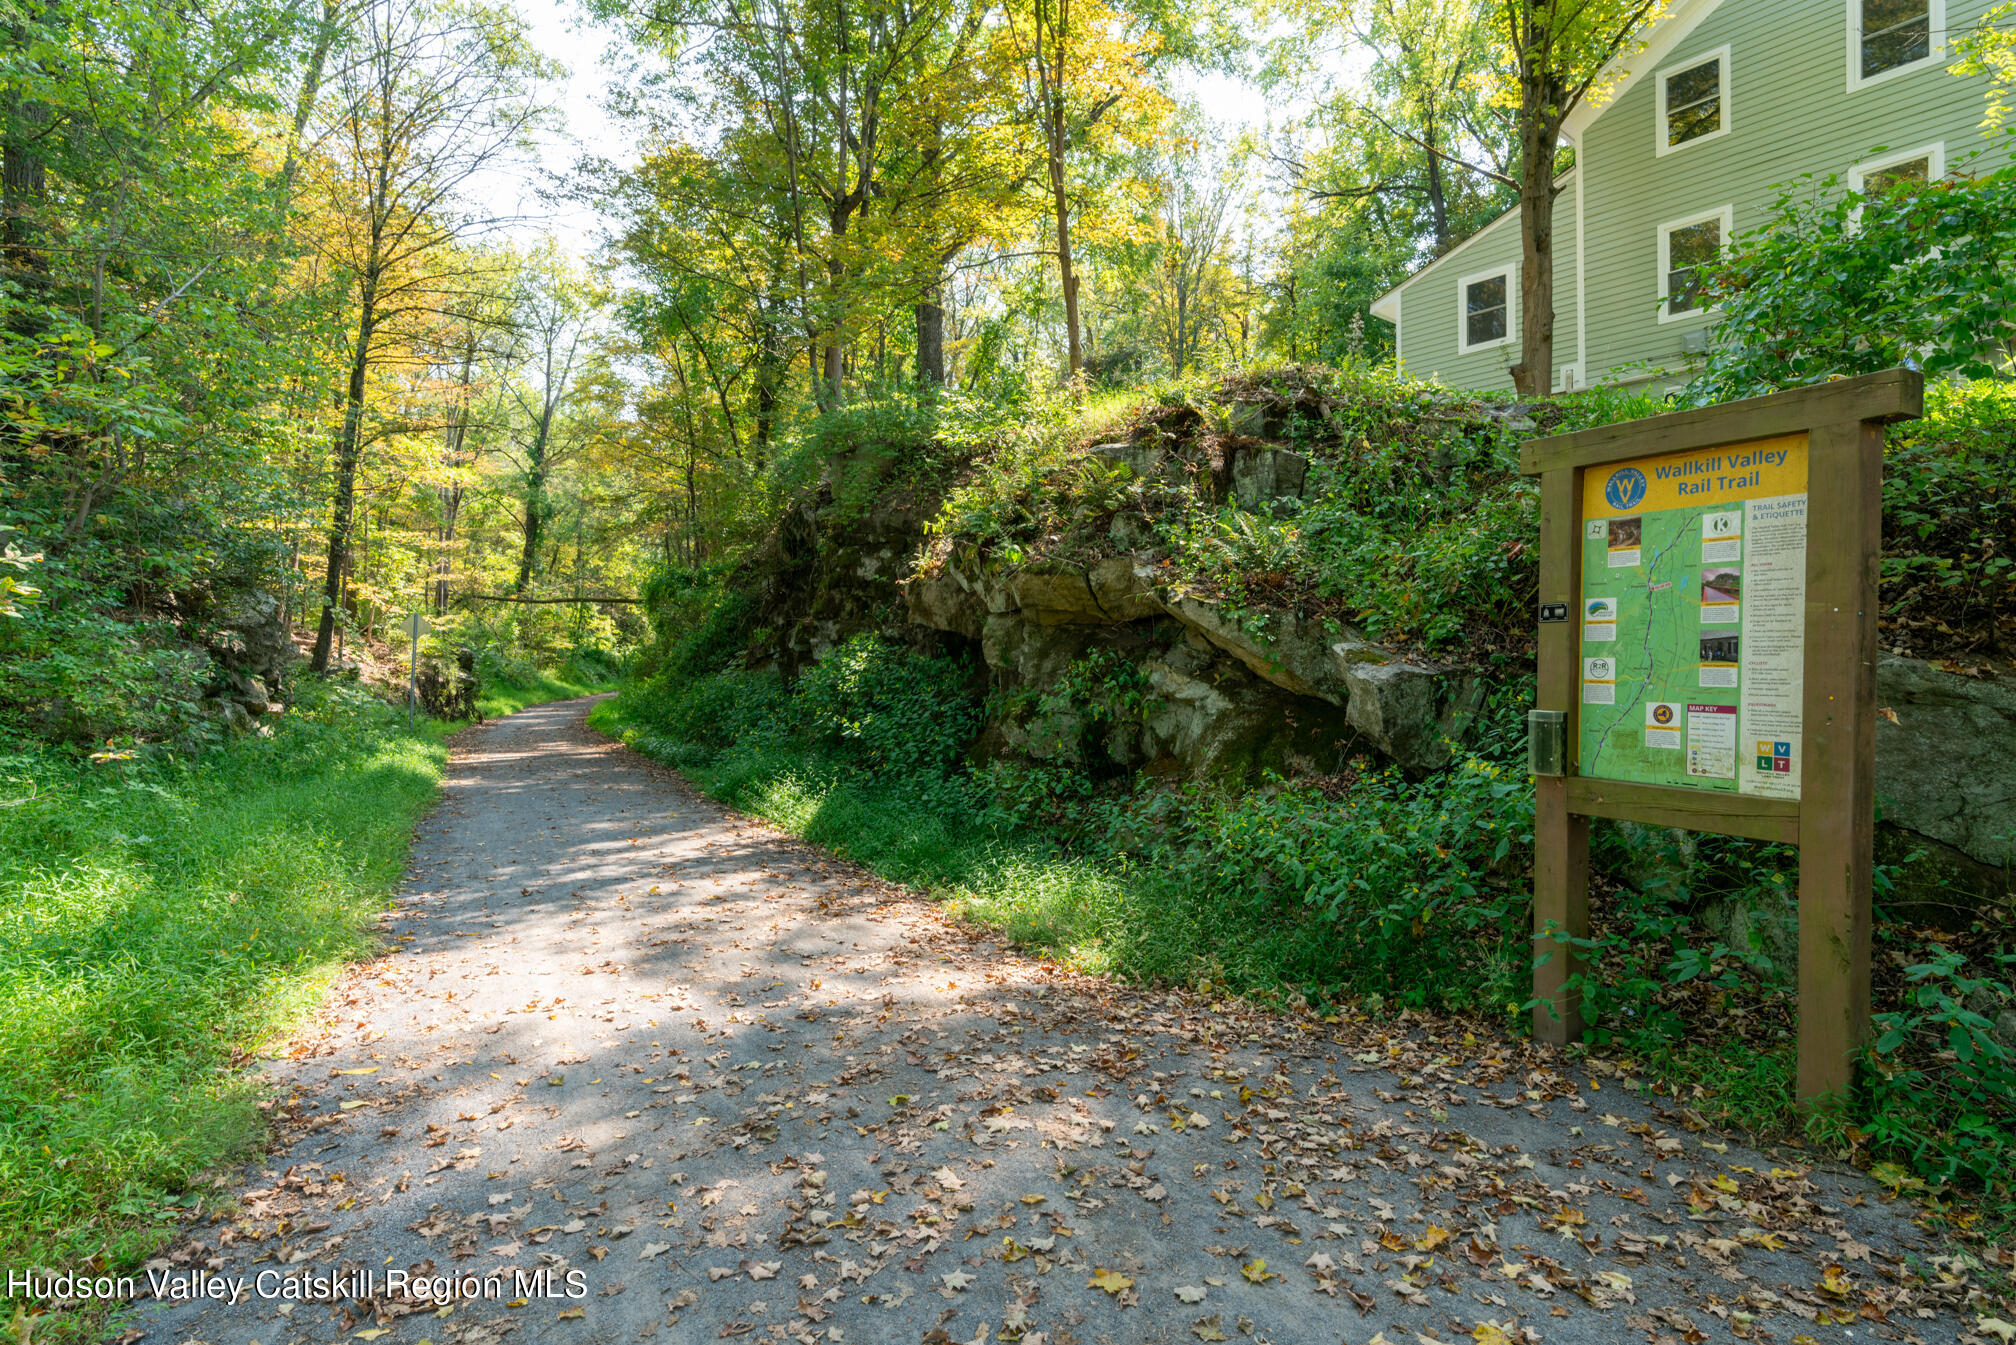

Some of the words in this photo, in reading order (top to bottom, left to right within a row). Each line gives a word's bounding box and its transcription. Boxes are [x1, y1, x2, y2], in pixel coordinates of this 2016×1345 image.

[1655, 456, 1721, 480] Wallkill
[1728, 450, 1788, 469] Valley
[1678, 478, 1711, 496] Rail
[1717, 471, 1760, 490] Trail
[1752, 503, 1775, 512] TRAIL
[1777, 499, 1807, 510] SAFETY
[1760, 509, 1806, 520] ETIQUETTE
[1760, 743, 1770, 752] W
[1777, 744, 1786, 753] V
[1761, 759, 1768, 768] L
[1777, 760, 1786, 769] T
